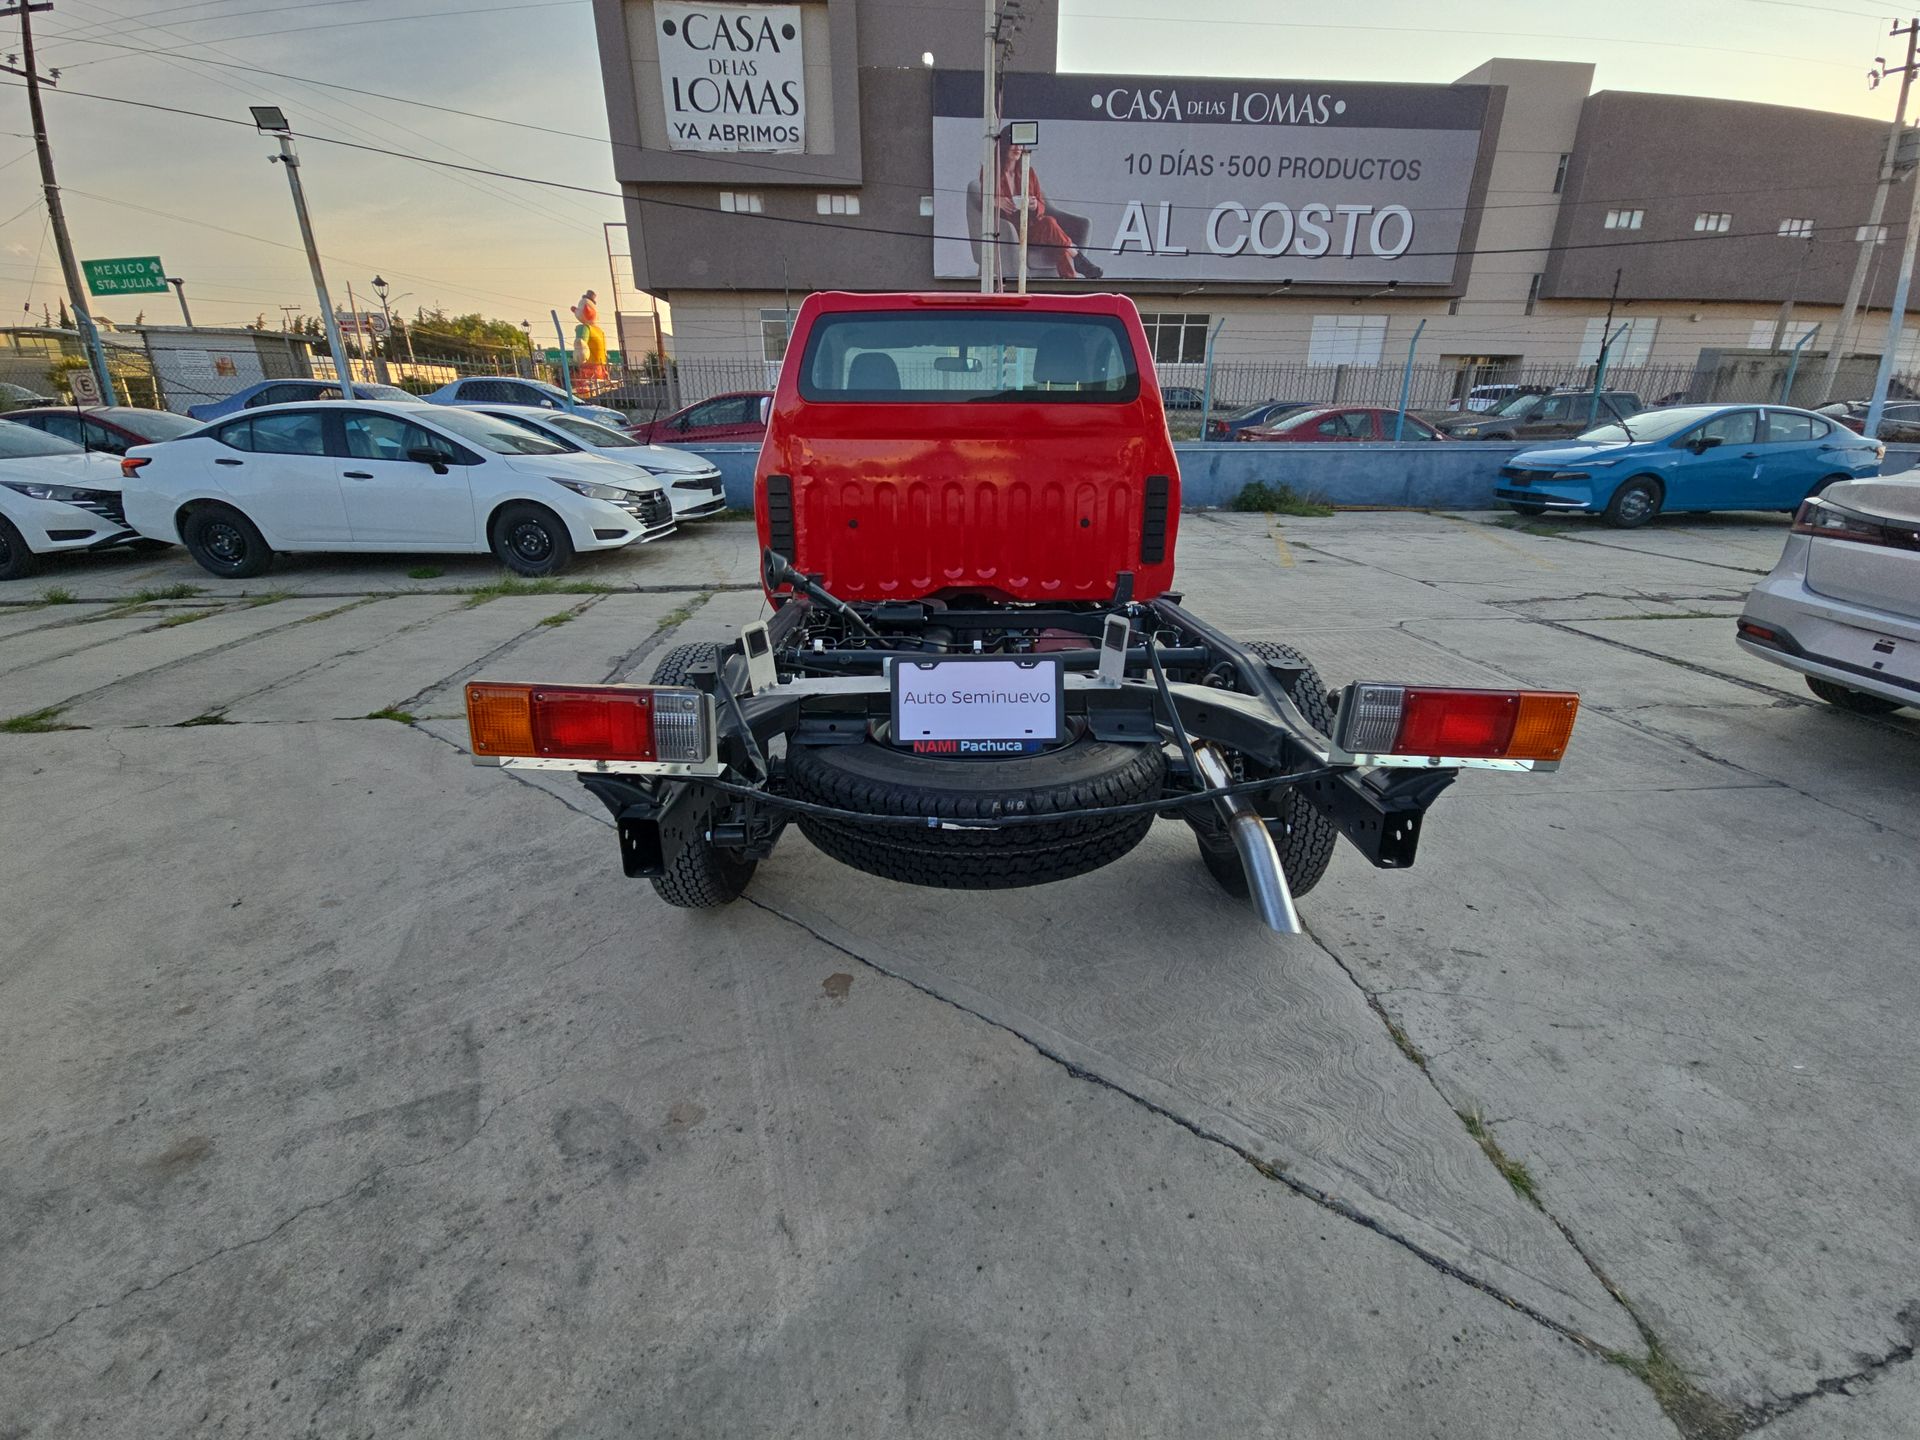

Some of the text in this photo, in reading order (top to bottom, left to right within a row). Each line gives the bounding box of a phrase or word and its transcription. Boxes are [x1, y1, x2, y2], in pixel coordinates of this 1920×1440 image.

[682, 13, 781, 53] CASA
[672, 76, 800, 116] LOMAS
[1106, 88, 1183, 121] CASA
[1231, 92, 1332, 124] LOMAS
[673, 122, 800, 143] YA ABRIMOS
[1124, 153, 1152, 175] 10
[1278, 156, 1422, 181] PRODUCTOS
[1112, 199, 1415, 260] AL COSTO
[93, 263, 145, 276] MEXICO
[96, 277, 155, 290] STA JULIA
[80, 379, 92, 392] E
[903, 690, 1051, 705] Auto Seminuevo
[913, 740, 1023, 753] NAMI Pachuca
